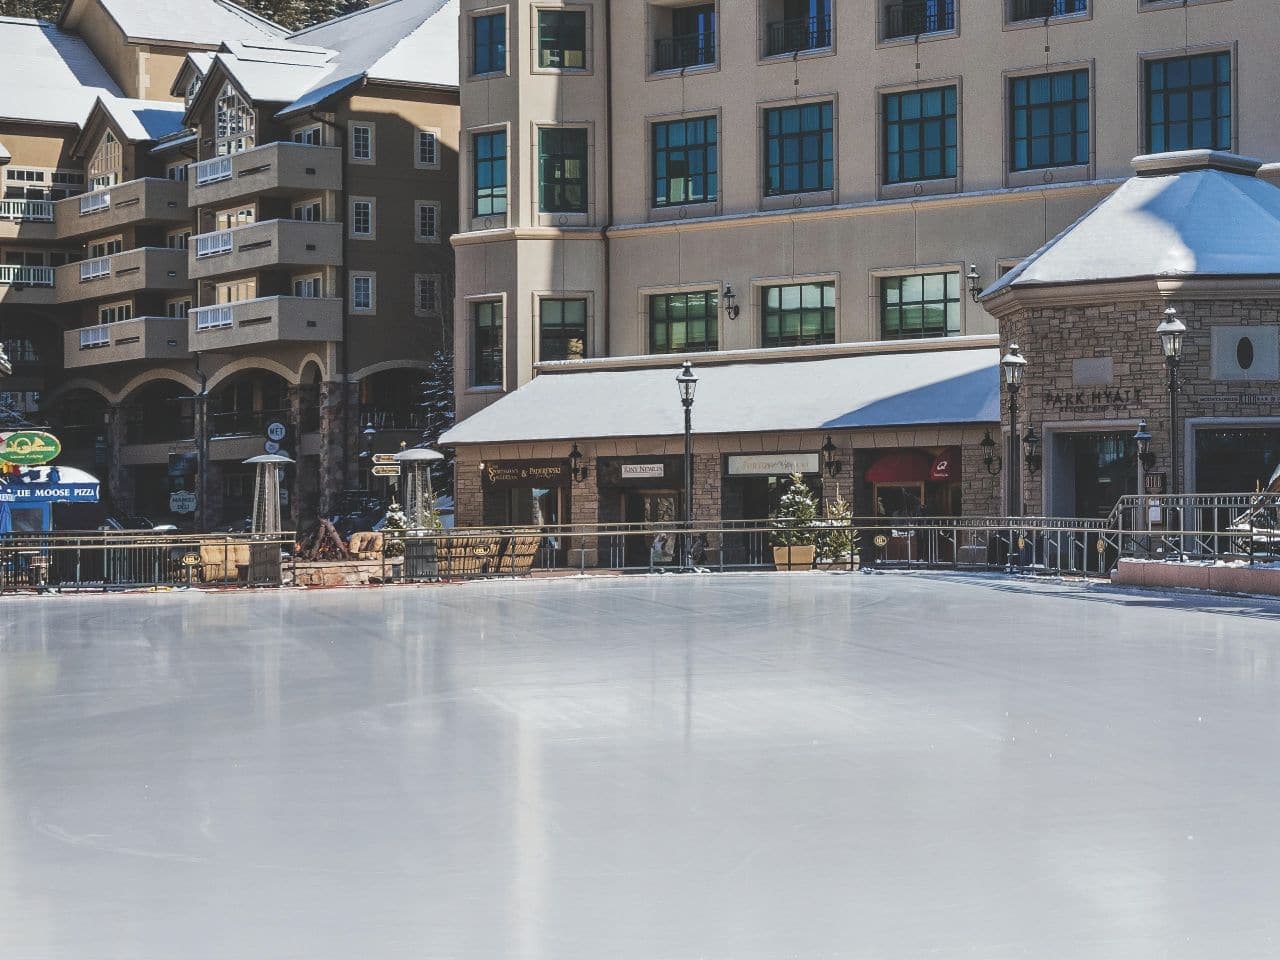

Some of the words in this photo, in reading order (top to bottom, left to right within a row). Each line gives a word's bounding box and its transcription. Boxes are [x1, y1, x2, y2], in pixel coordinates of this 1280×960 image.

[1046, 392, 1086, 405] PARK
[1092, 389, 1141, 404] HYATT
[35, 489, 70, 497] MOOSE
[73, 488, 95, 496] PIZZA
